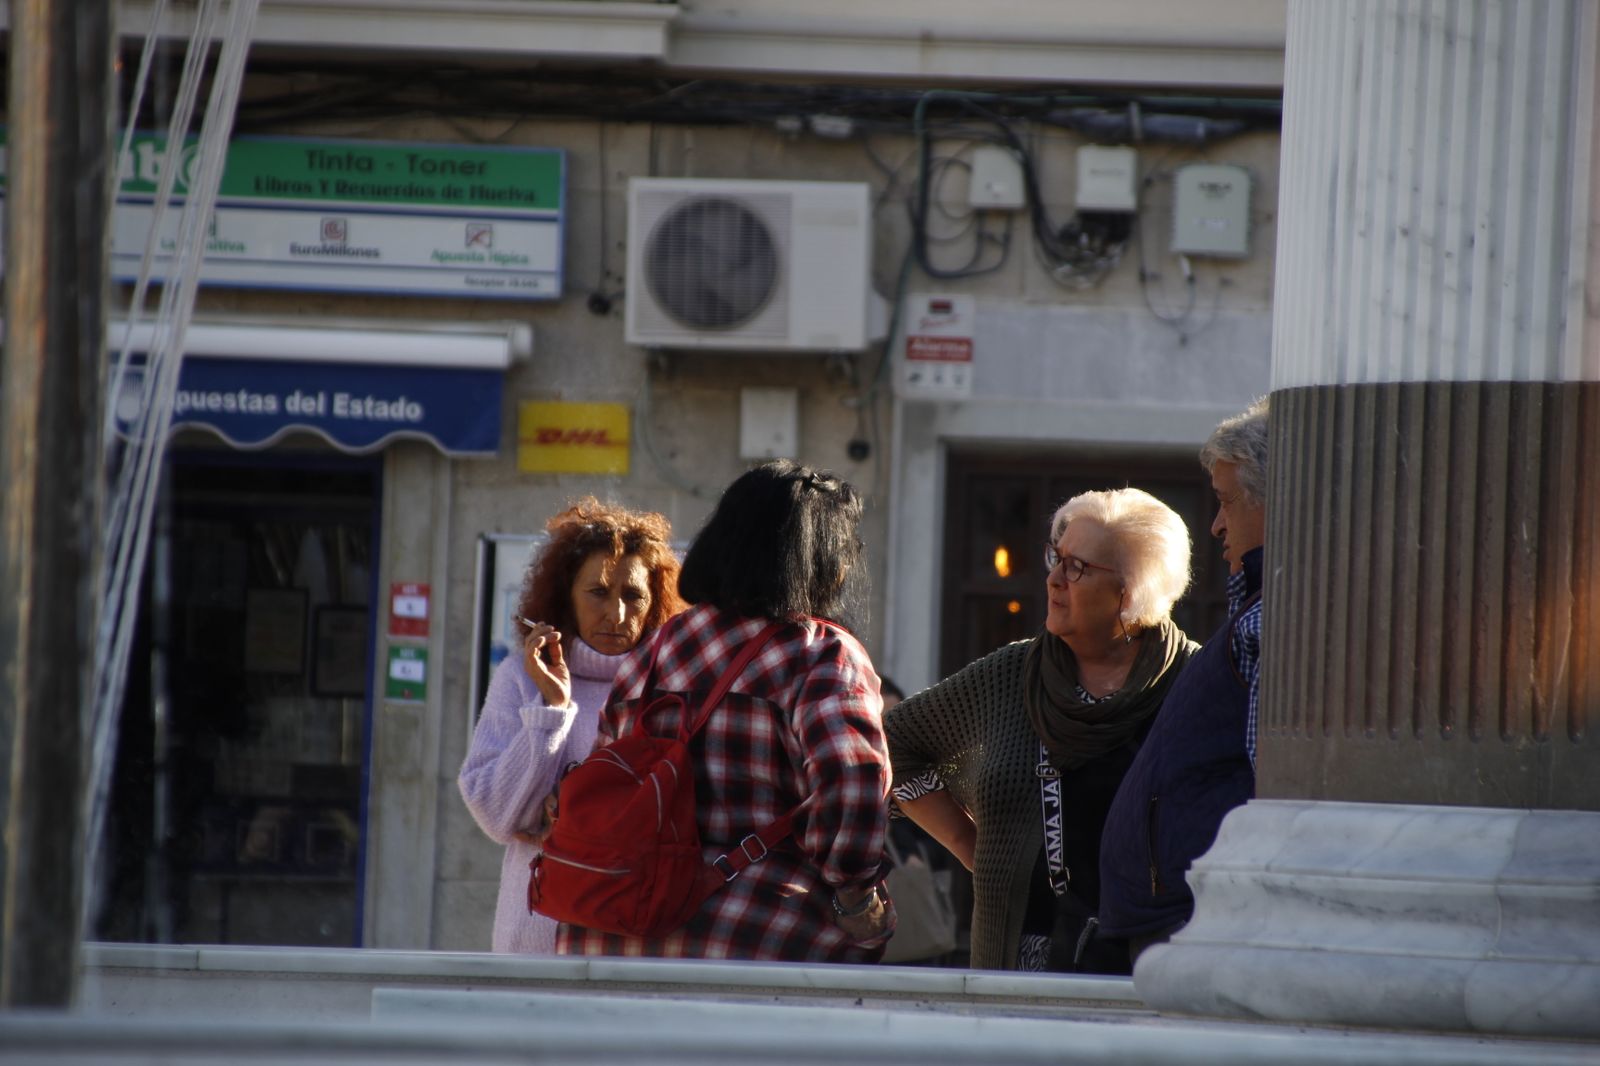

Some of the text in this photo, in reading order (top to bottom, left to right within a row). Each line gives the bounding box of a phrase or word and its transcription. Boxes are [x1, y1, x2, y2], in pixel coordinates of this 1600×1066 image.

[304, 148, 374, 174] Tinta
[405, 152, 489, 178] Toner
[253, 175, 313, 196] Libros
[335, 180, 436, 201] Recuerdos
[441, 183, 463, 201] de
[170, 388, 424, 422] puestas del Estado
[537, 428, 609, 446] DHL
